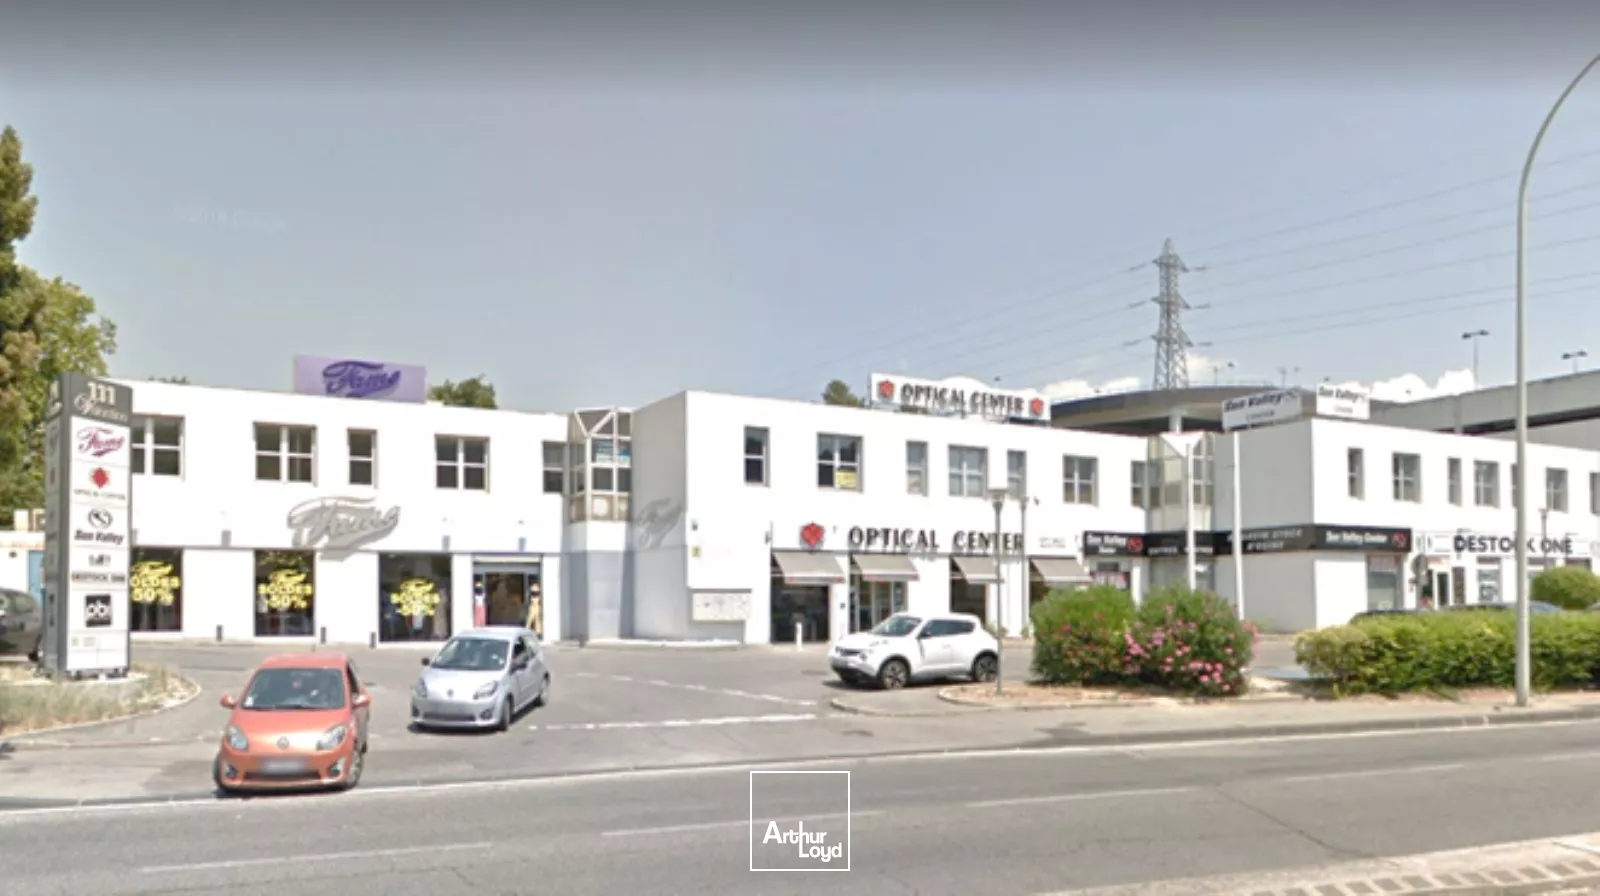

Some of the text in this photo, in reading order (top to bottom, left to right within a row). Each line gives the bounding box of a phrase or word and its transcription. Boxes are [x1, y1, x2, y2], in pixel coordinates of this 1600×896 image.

[902, 382, 1024, 414] OPTICAL CENTER
[850, 526, 939, 549] OPTICAL
[953, 531, 1024, 550] CENTER
[1541, 538, 1573, 554] ONE
[130, 576, 180, 589] OLDES
